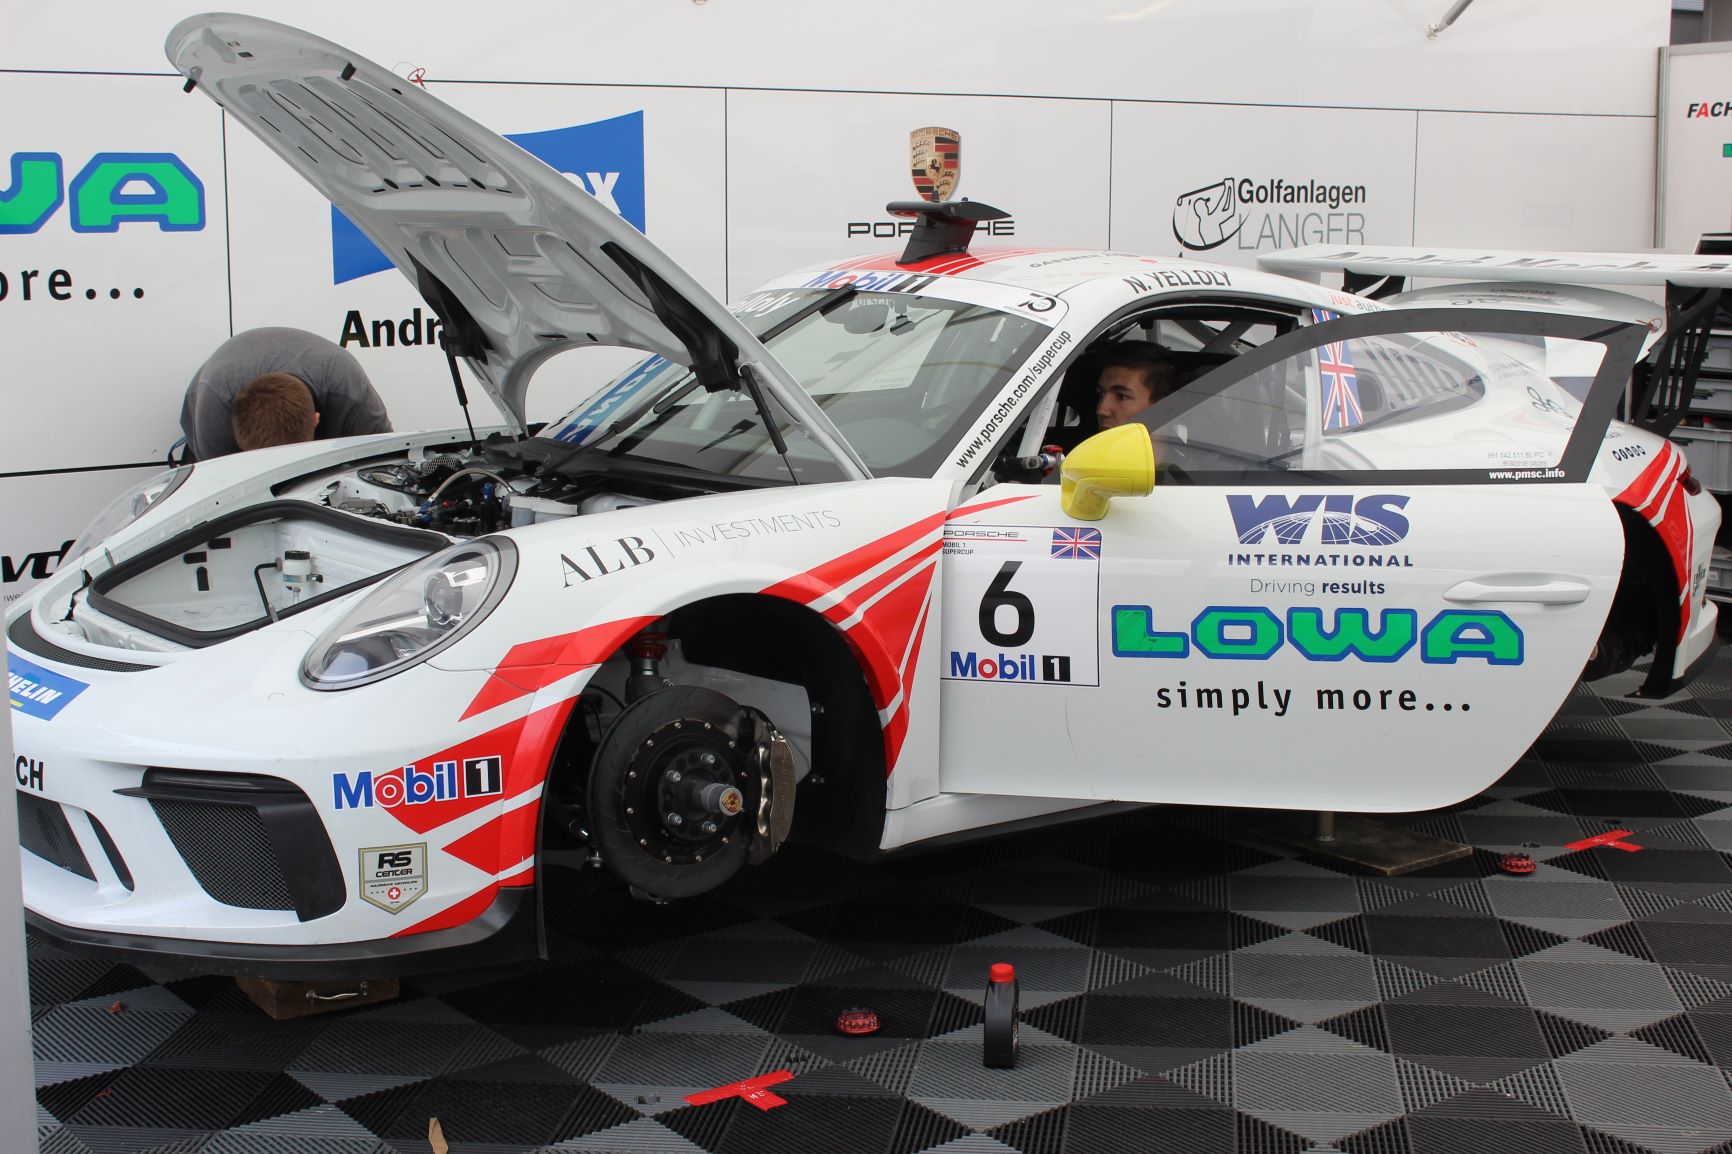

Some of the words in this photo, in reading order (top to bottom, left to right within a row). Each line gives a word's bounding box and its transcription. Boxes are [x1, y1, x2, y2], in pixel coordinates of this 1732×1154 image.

[1237, 178, 1366, 209] Golfanlagen
[1238, 212, 1366, 250] LANGER
[801, 271, 902, 291] Mobil
[895, 275, 934, 293] 1
[1147, 269, 1232, 288] YELLOLY
[339, 308, 443, 348] Andr
[956, 329, 1072, 469] www.porsche.com/supercup
[1488, 468, 1565, 480] www.pmsc.info
[943, 530, 1020, 538] PORSCHE
[1225, 494, 1411, 546] WIS
[560, 536, 655, 589] ALB
[673, 510, 841, 548] INVESTMENTS
[1228, 553, 1414, 568] INTERNATIONAL
[1250, 578, 1316, 597] Driving
[1321, 579, 1386, 596] results
[978, 561, 1035, 648] 6
[1111, 605, 1525, 666] LOWA
[950, 651, 1036, 681] Mobil
[1047, 657, 1065, 681] 1
[8, 672, 64, 705] HELIN
[1156, 681, 1292, 717] simply
[1316, 686, 1471, 713] more...
[15, 755, 44, 792] CH
[332, 761, 457, 810] Mobil
[471, 759, 495, 794] 1
[375, 868, 413, 878] CENTER
[377, 850, 412, 869] RS
